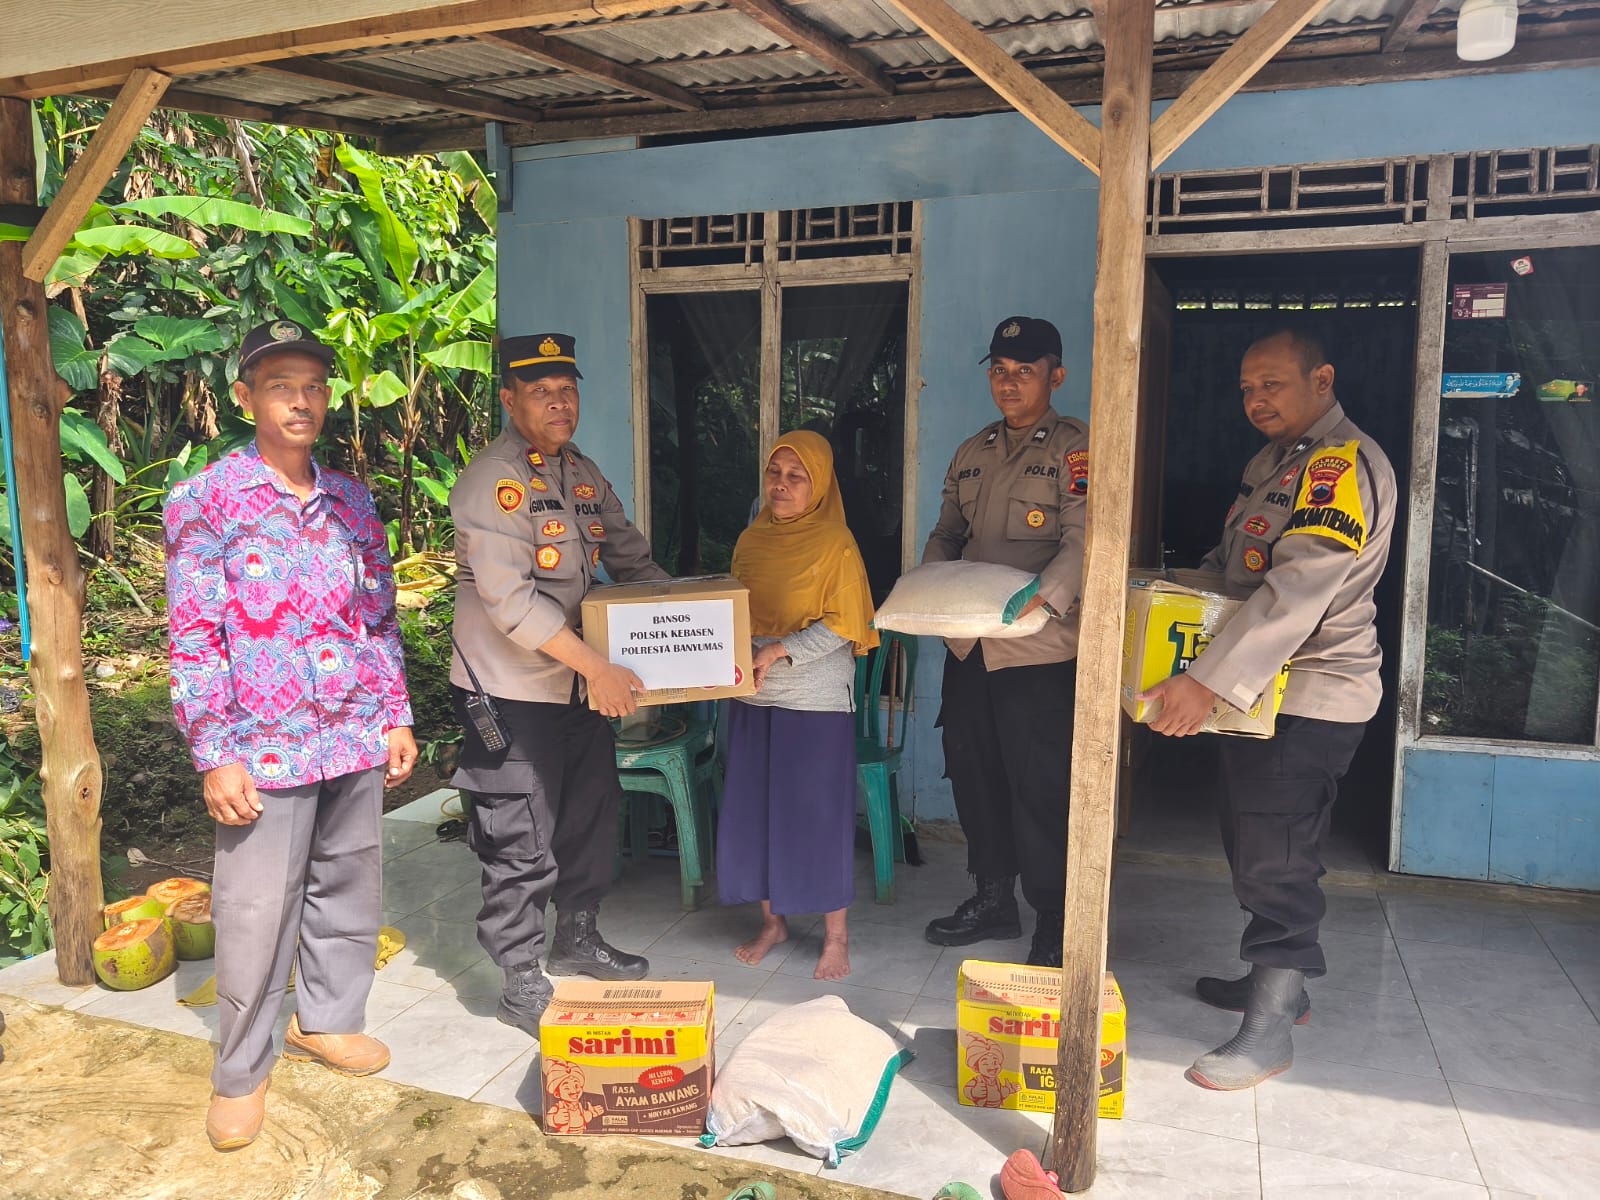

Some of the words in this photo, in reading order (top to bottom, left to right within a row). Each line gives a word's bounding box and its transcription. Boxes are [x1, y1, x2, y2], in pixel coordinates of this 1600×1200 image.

[1024, 465, 1059, 479] POLRI
[575, 503, 602, 516] POLRI
[653, 614, 691, 625] BANSOS
[630, 630, 668, 640] POLSEK
[671, 628, 714, 638] KEBASEN
[621, 645, 671, 655] POLRESTA
[673, 642, 724, 653] BANYUMAS
[989, 1013, 1060, 1038] sari
[568, 1028, 676, 1056] sarimi
[1030, 1066, 1053, 1076] RASA
[651, 1076, 675, 1086] KENYAL
[1040, 1077, 1058, 1089] IG
[612, 1085, 635, 1094] RASA
[616, 1095, 649, 1107] AYAM
[651, 1085, 699, 1105] BAWANG
[672, 1103, 698, 1114] BAWANG
